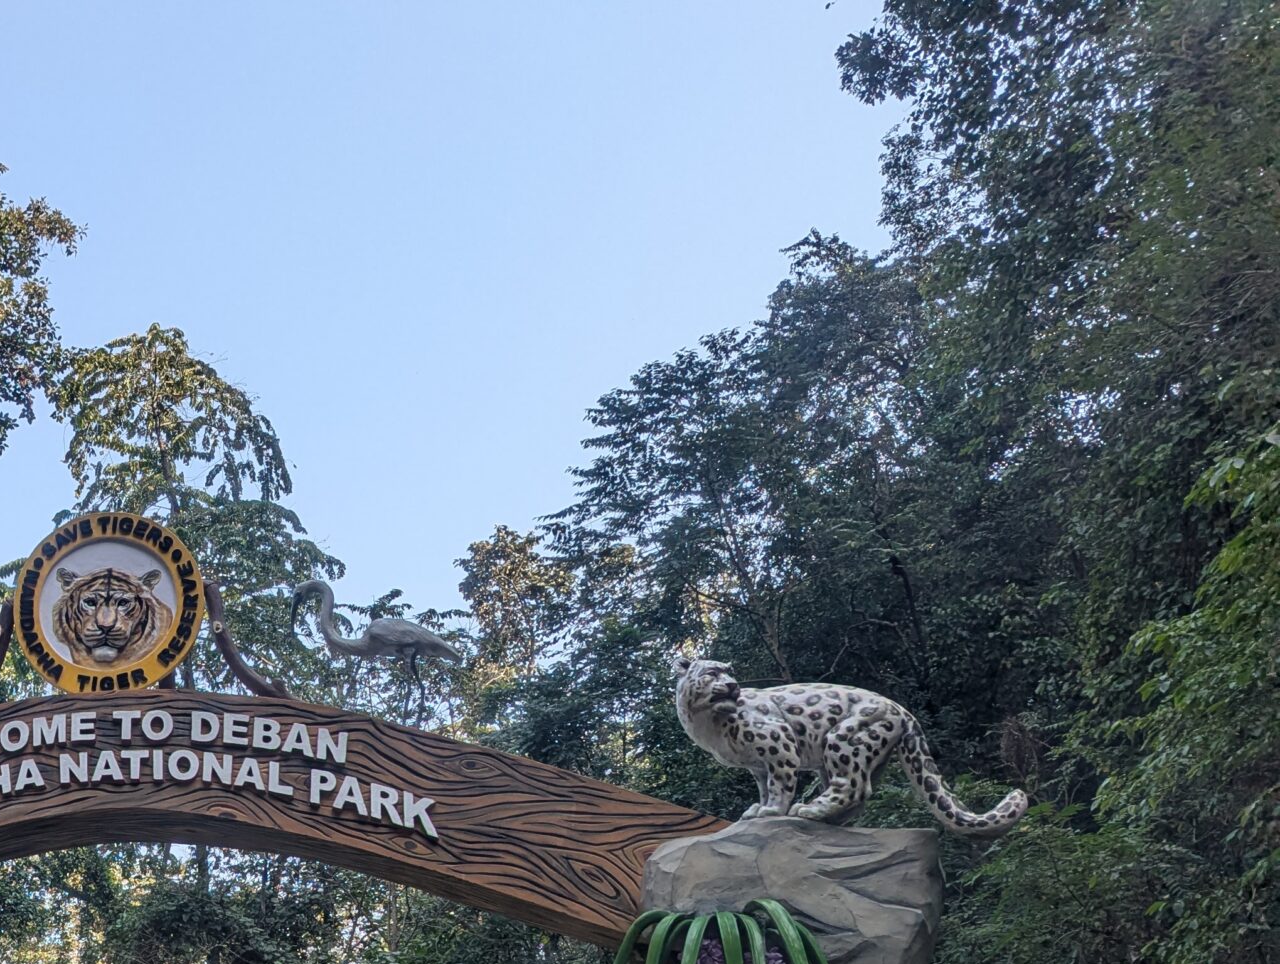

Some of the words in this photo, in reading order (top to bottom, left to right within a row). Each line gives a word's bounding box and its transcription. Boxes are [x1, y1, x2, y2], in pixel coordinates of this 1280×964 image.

[41, 518, 93, 559] SAVE
[97, 516, 173, 554] TIGERS
[21, 569, 64, 684] NAMDAPHA
[77, 668, 148, 693] TIGER
[157, 560, 199, 667] RESERVE
[113, 709, 174, 742] TO
[190, 710, 348, 764] DEBAN
[59, 749, 294, 797] NATIONAL
[309, 768, 438, 839] PARK
